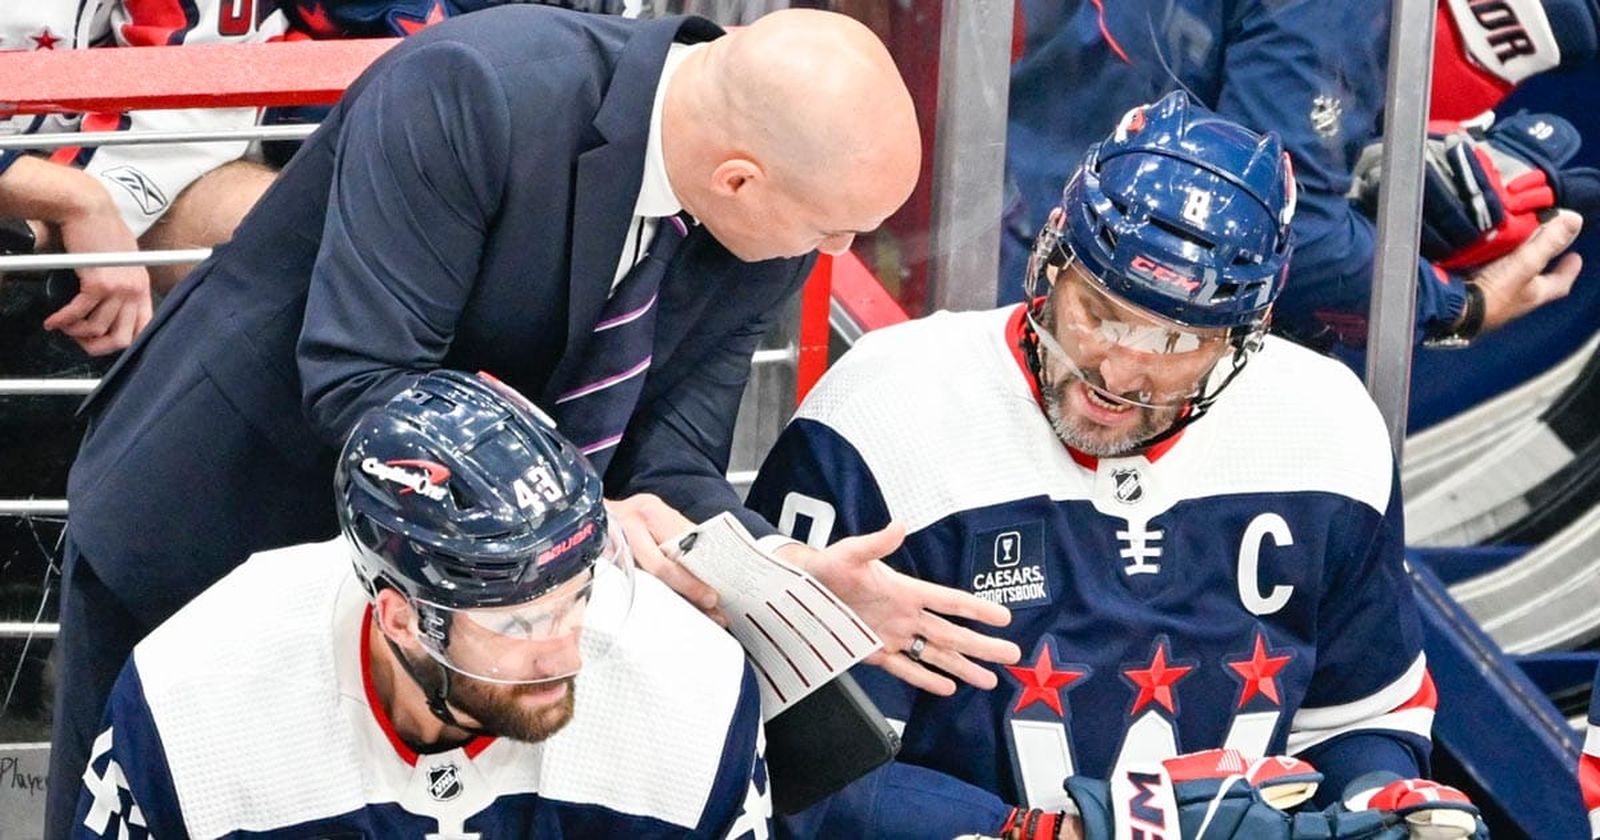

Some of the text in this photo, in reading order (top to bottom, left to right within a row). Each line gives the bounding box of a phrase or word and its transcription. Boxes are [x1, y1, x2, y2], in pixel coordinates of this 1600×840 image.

[1183, 187, 1211, 226] 8
[513, 465, 563, 518] 43
[536, 522, 594, 566] BAUER
[1237, 512, 1295, 616] C
